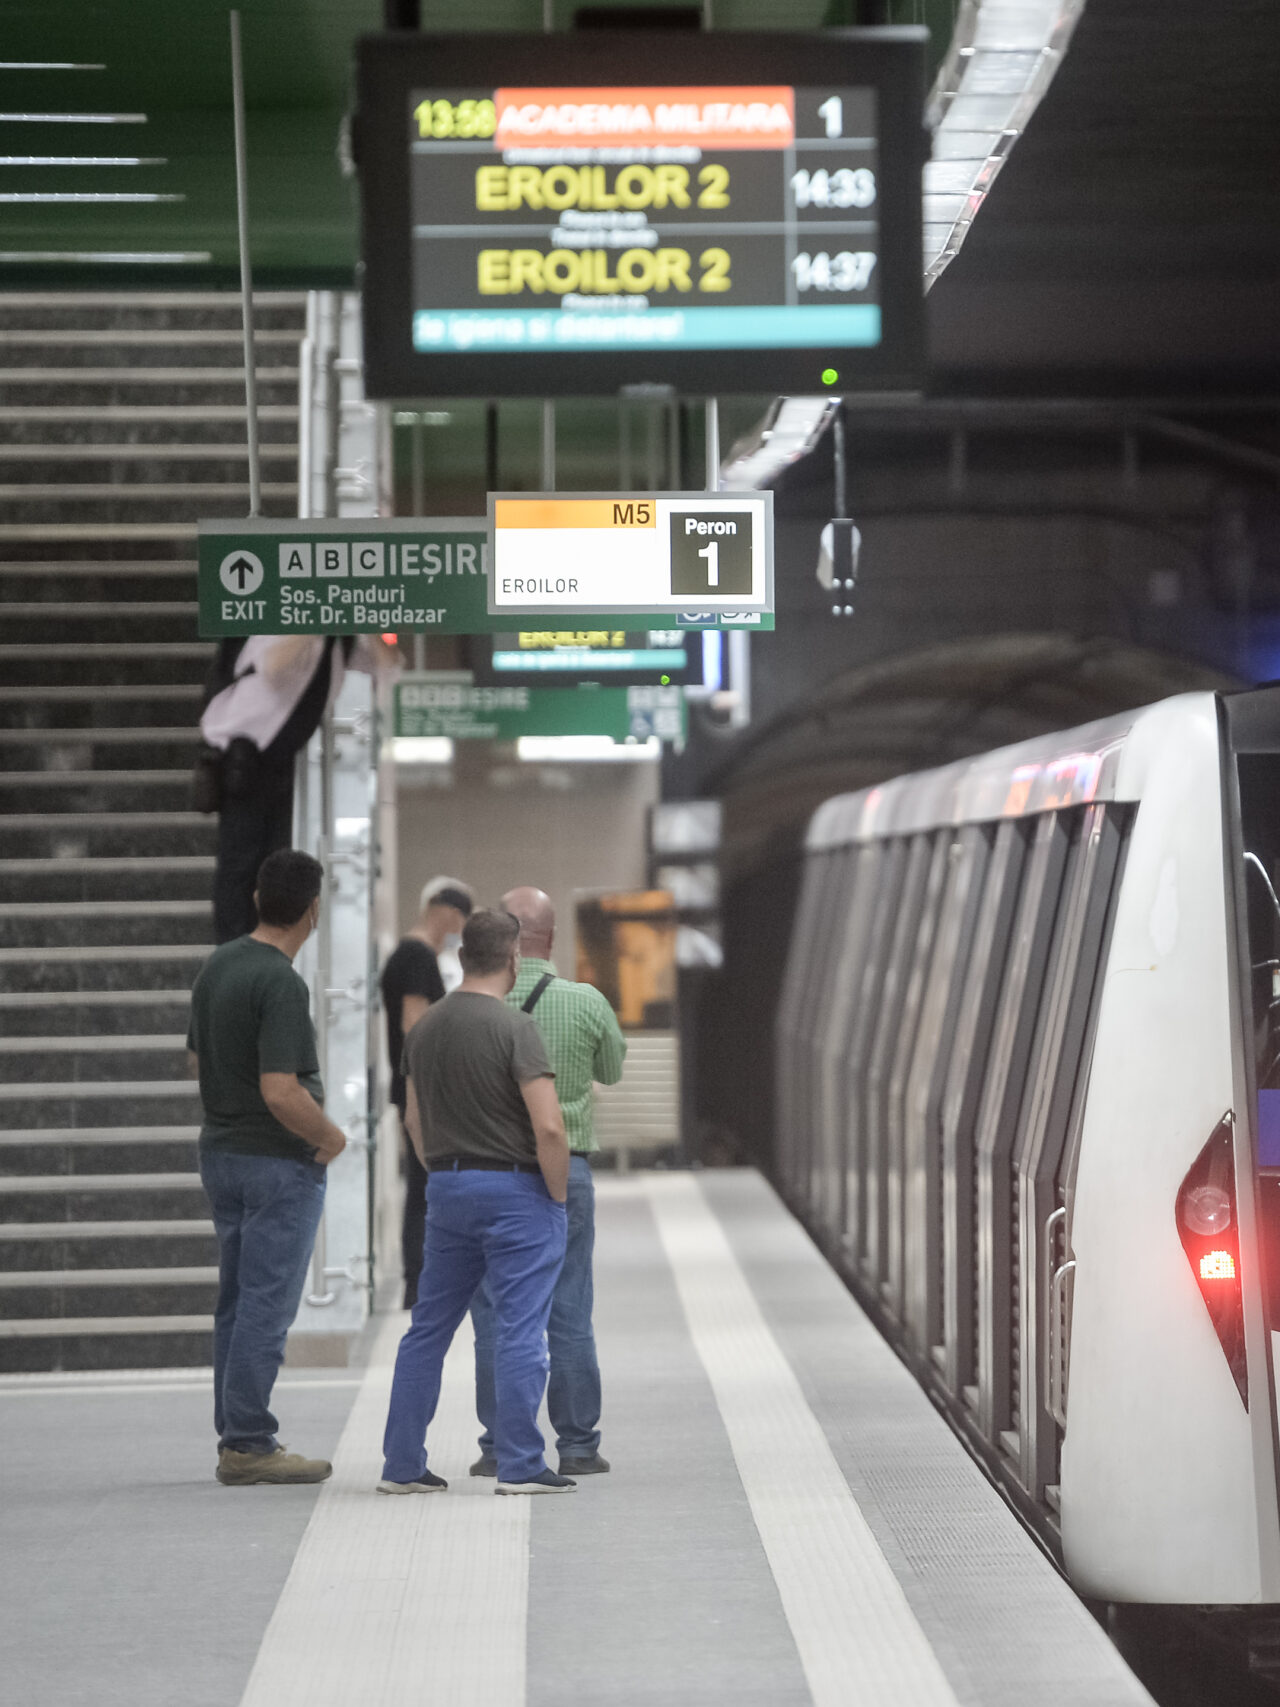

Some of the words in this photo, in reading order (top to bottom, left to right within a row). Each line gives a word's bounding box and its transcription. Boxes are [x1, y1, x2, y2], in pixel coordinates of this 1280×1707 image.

[818, 96, 842, 139] 1
[475, 164, 691, 211] EROILOR
[697, 164, 731, 209] 2
[477, 247, 692, 295] EROILOR
[698, 247, 732, 293] 2
[791, 251, 878, 292] 14:37
[612, 502, 651, 525] M5
[684, 517, 738, 536] Peron
[287, 549, 304, 571] A
[323, 549, 341, 571] B
[359, 548, 377, 571] C
[697, 541, 720, 587] 1
[279, 585, 322, 604] Sos.
[327, 584, 406, 604] Panduri
[501, 577, 579, 594] EROILOR
[220, 600, 267, 621] EXIT
[279, 605, 314, 625] Str.
[320, 605, 348, 625] Dr.
[353, 605, 448, 629] Bagdazar
